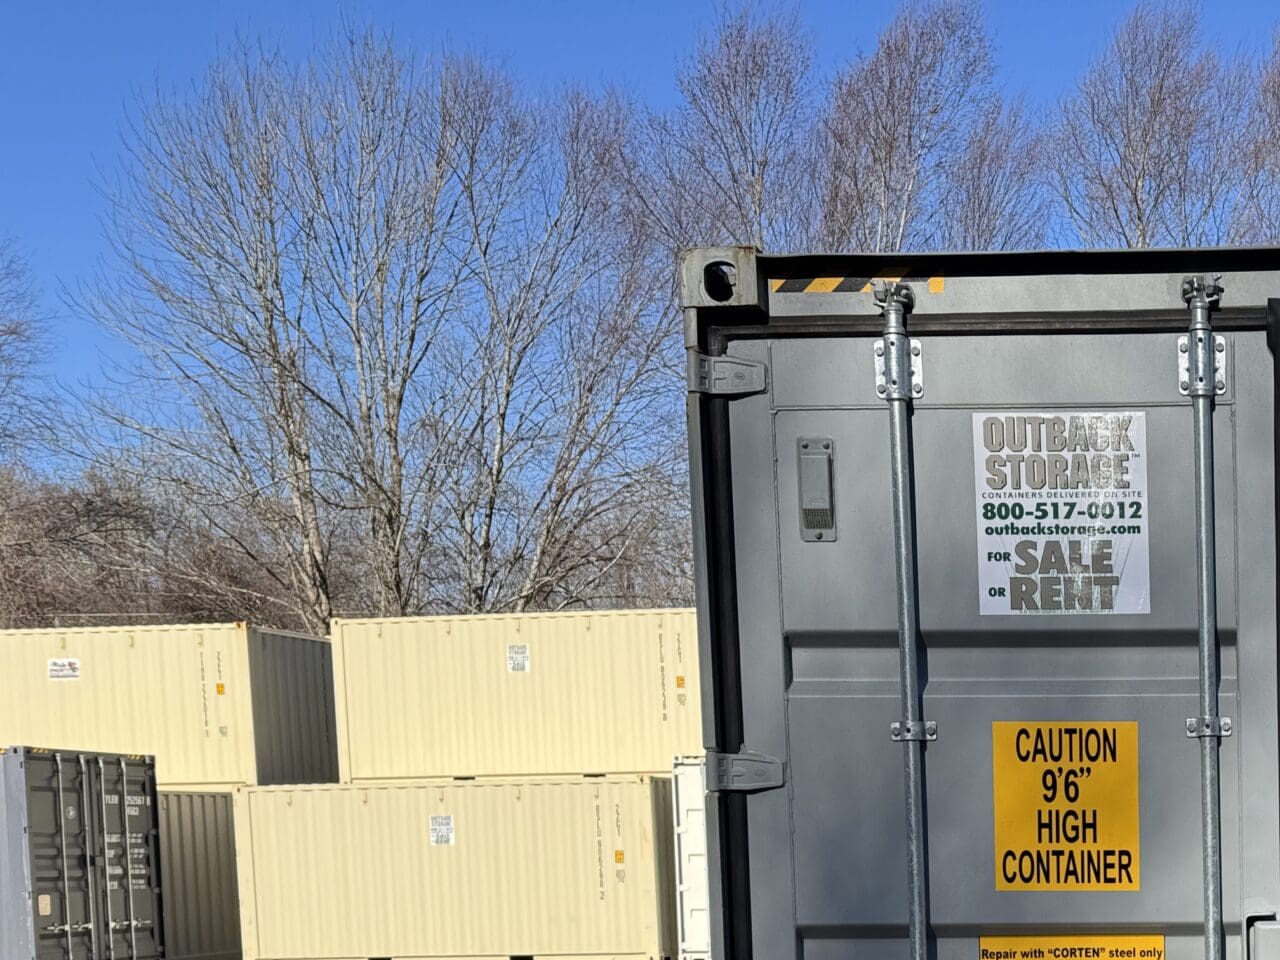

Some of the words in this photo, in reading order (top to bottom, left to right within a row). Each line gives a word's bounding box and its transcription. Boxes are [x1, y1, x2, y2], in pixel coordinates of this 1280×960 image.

[982, 416, 1135, 452] OUTBACK
[985, 453, 1130, 490] STORAGE
[982, 491, 1043, 499] CONTAINERS
[1047, 491, 1100, 499] DELIVERED
[1122, 490, 1143, 498] SITE
[982, 501, 1143, 520] 800-517-0012
[984, 523, 1141, 536] outbackstorage.com
[987, 552, 1011, 562] FOR
[1014, 540, 1113, 575] SALE
[988, 587, 1006, 597] OR
[1010, 576, 1119, 610] RENT
[1015, 728, 1117, 763] CAUTION
[1037, 809, 1097, 843] HIGH
[1002, 850, 1133, 884] CONTAINER
[981, 949, 1017, 960] Repair
[1020, 948, 1045, 959] with
[1108, 947, 1136, 958] steel
[1139, 947, 1162, 960] only
